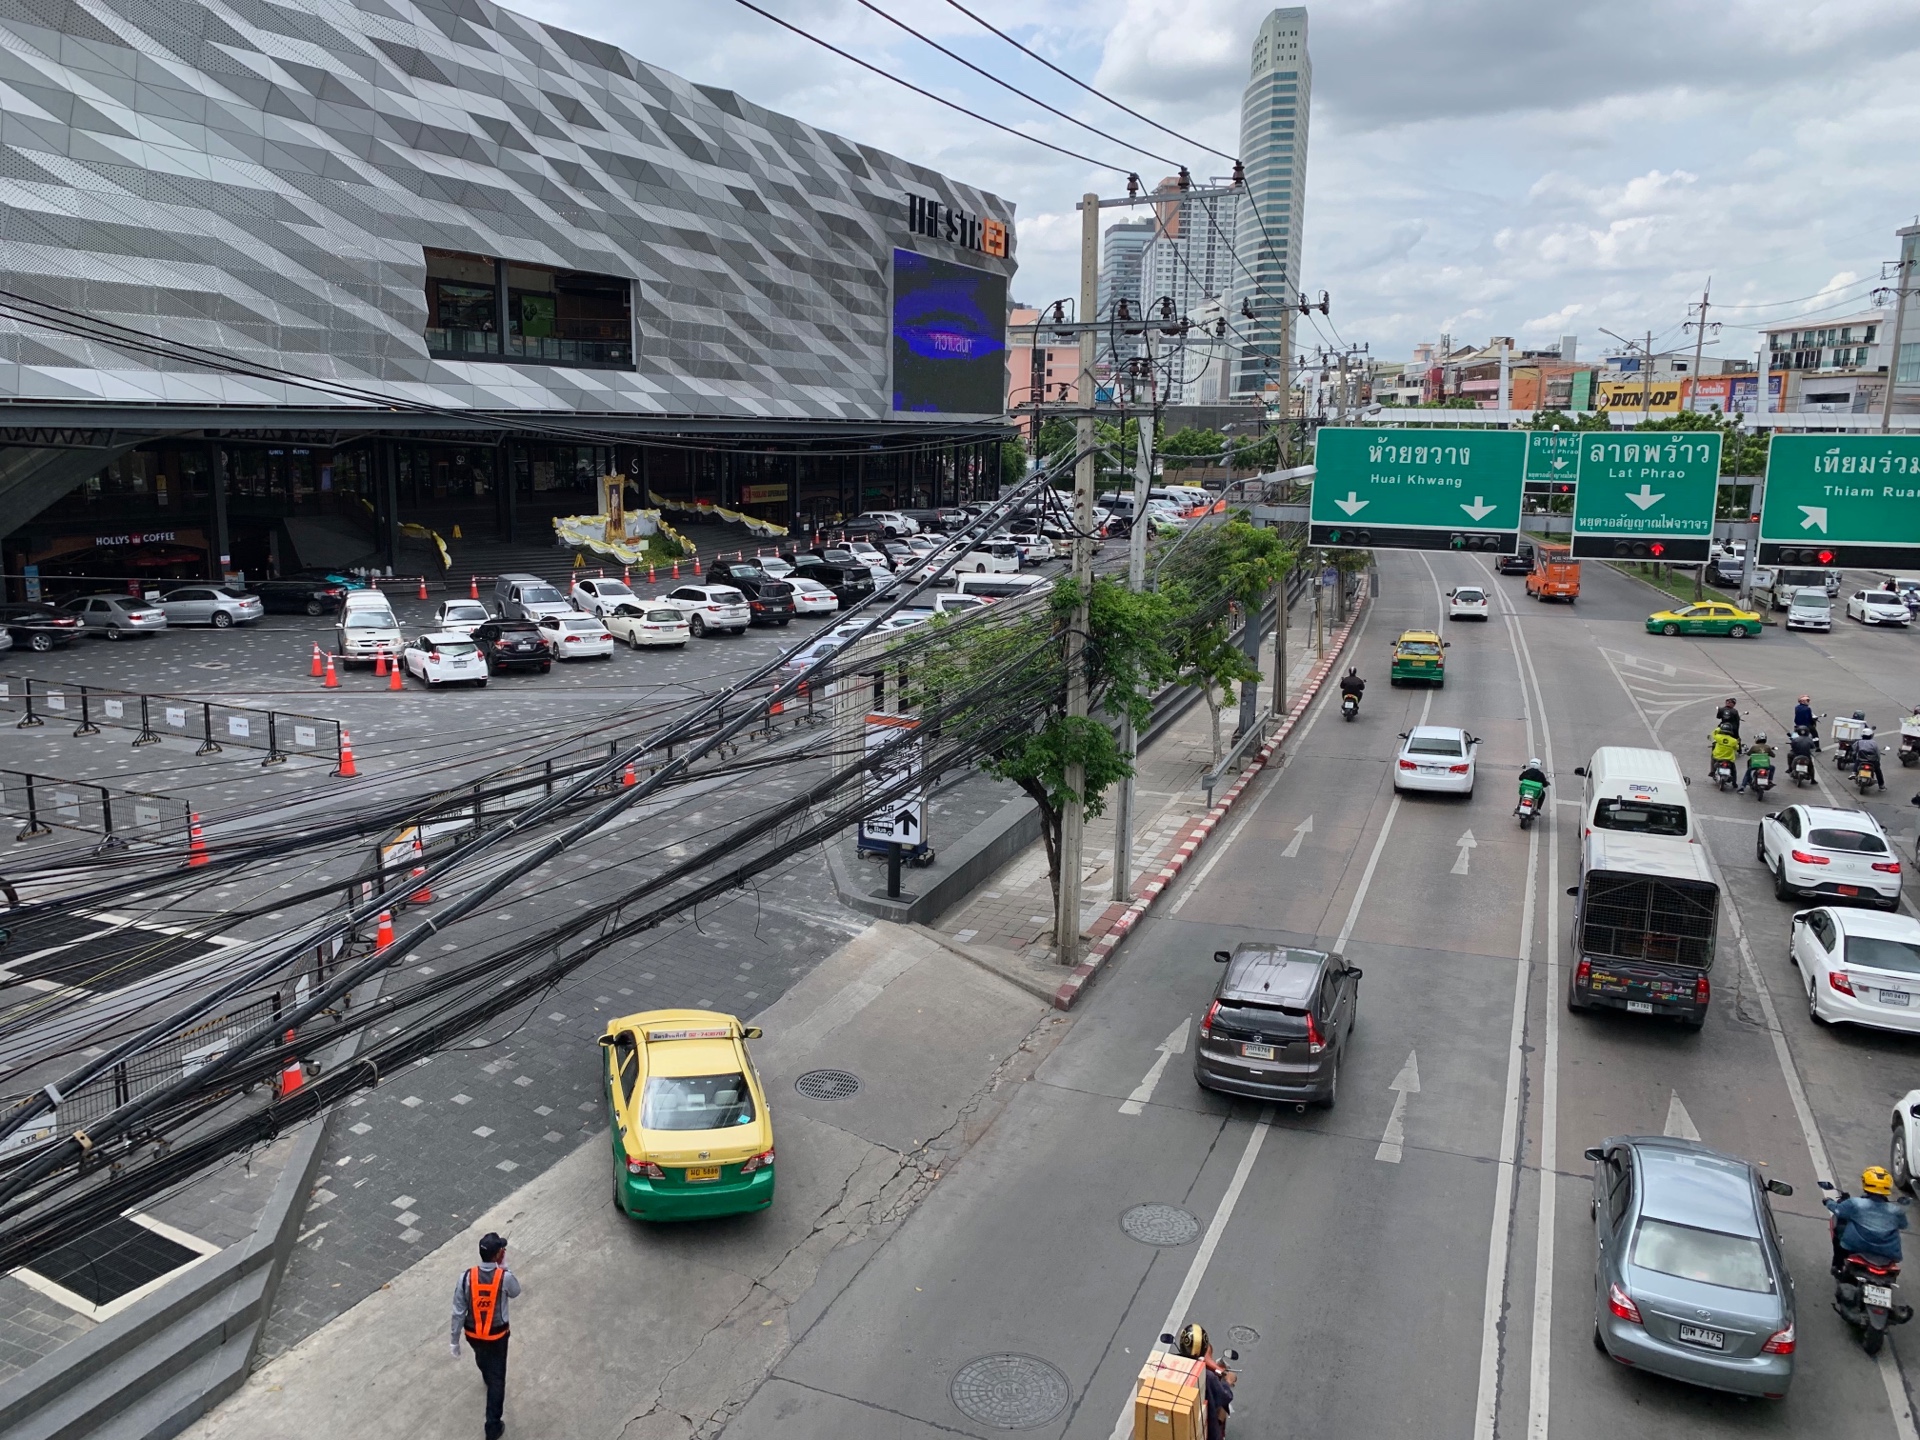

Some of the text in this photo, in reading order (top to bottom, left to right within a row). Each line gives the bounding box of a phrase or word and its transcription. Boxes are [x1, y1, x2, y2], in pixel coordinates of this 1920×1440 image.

[946, 208, 1011, 259] STREET
[1369, 436, 1471, 465] ห้วยขวาง
[1590, 435, 1710, 463] ลาดพร้าว
[1609, 468, 1685, 478] Lat Phrao
[1371, 474, 1463, 488] Huai Khwang
[1824, 486, 1920, 497] Thiam Rua
[1579, 514, 1708, 530] หยุดรอสัญญาณไฟจราจร
[96, 532, 175, 546] HOLLYS COFFEE
[1699, 1330, 1722, 1343] 7175
